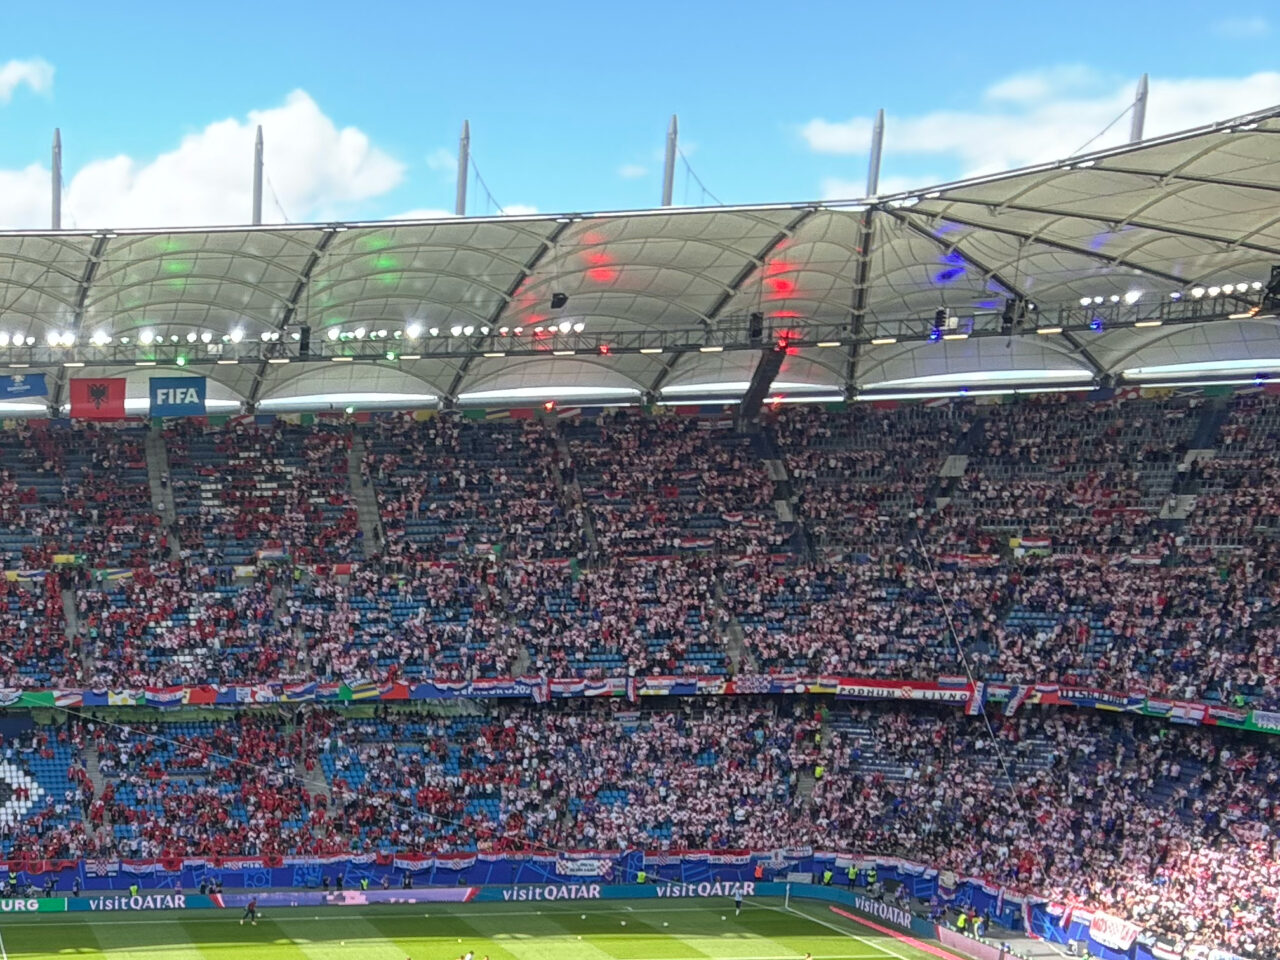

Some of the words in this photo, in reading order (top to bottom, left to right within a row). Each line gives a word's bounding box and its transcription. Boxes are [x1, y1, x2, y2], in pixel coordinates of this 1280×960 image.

[157, 387, 199, 405] FIFA
[503, 885, 600, 901] visitQATAR
[89, 894, 186, 911] visitQATAR
[855, 896, 911, 929] visitQATAR
